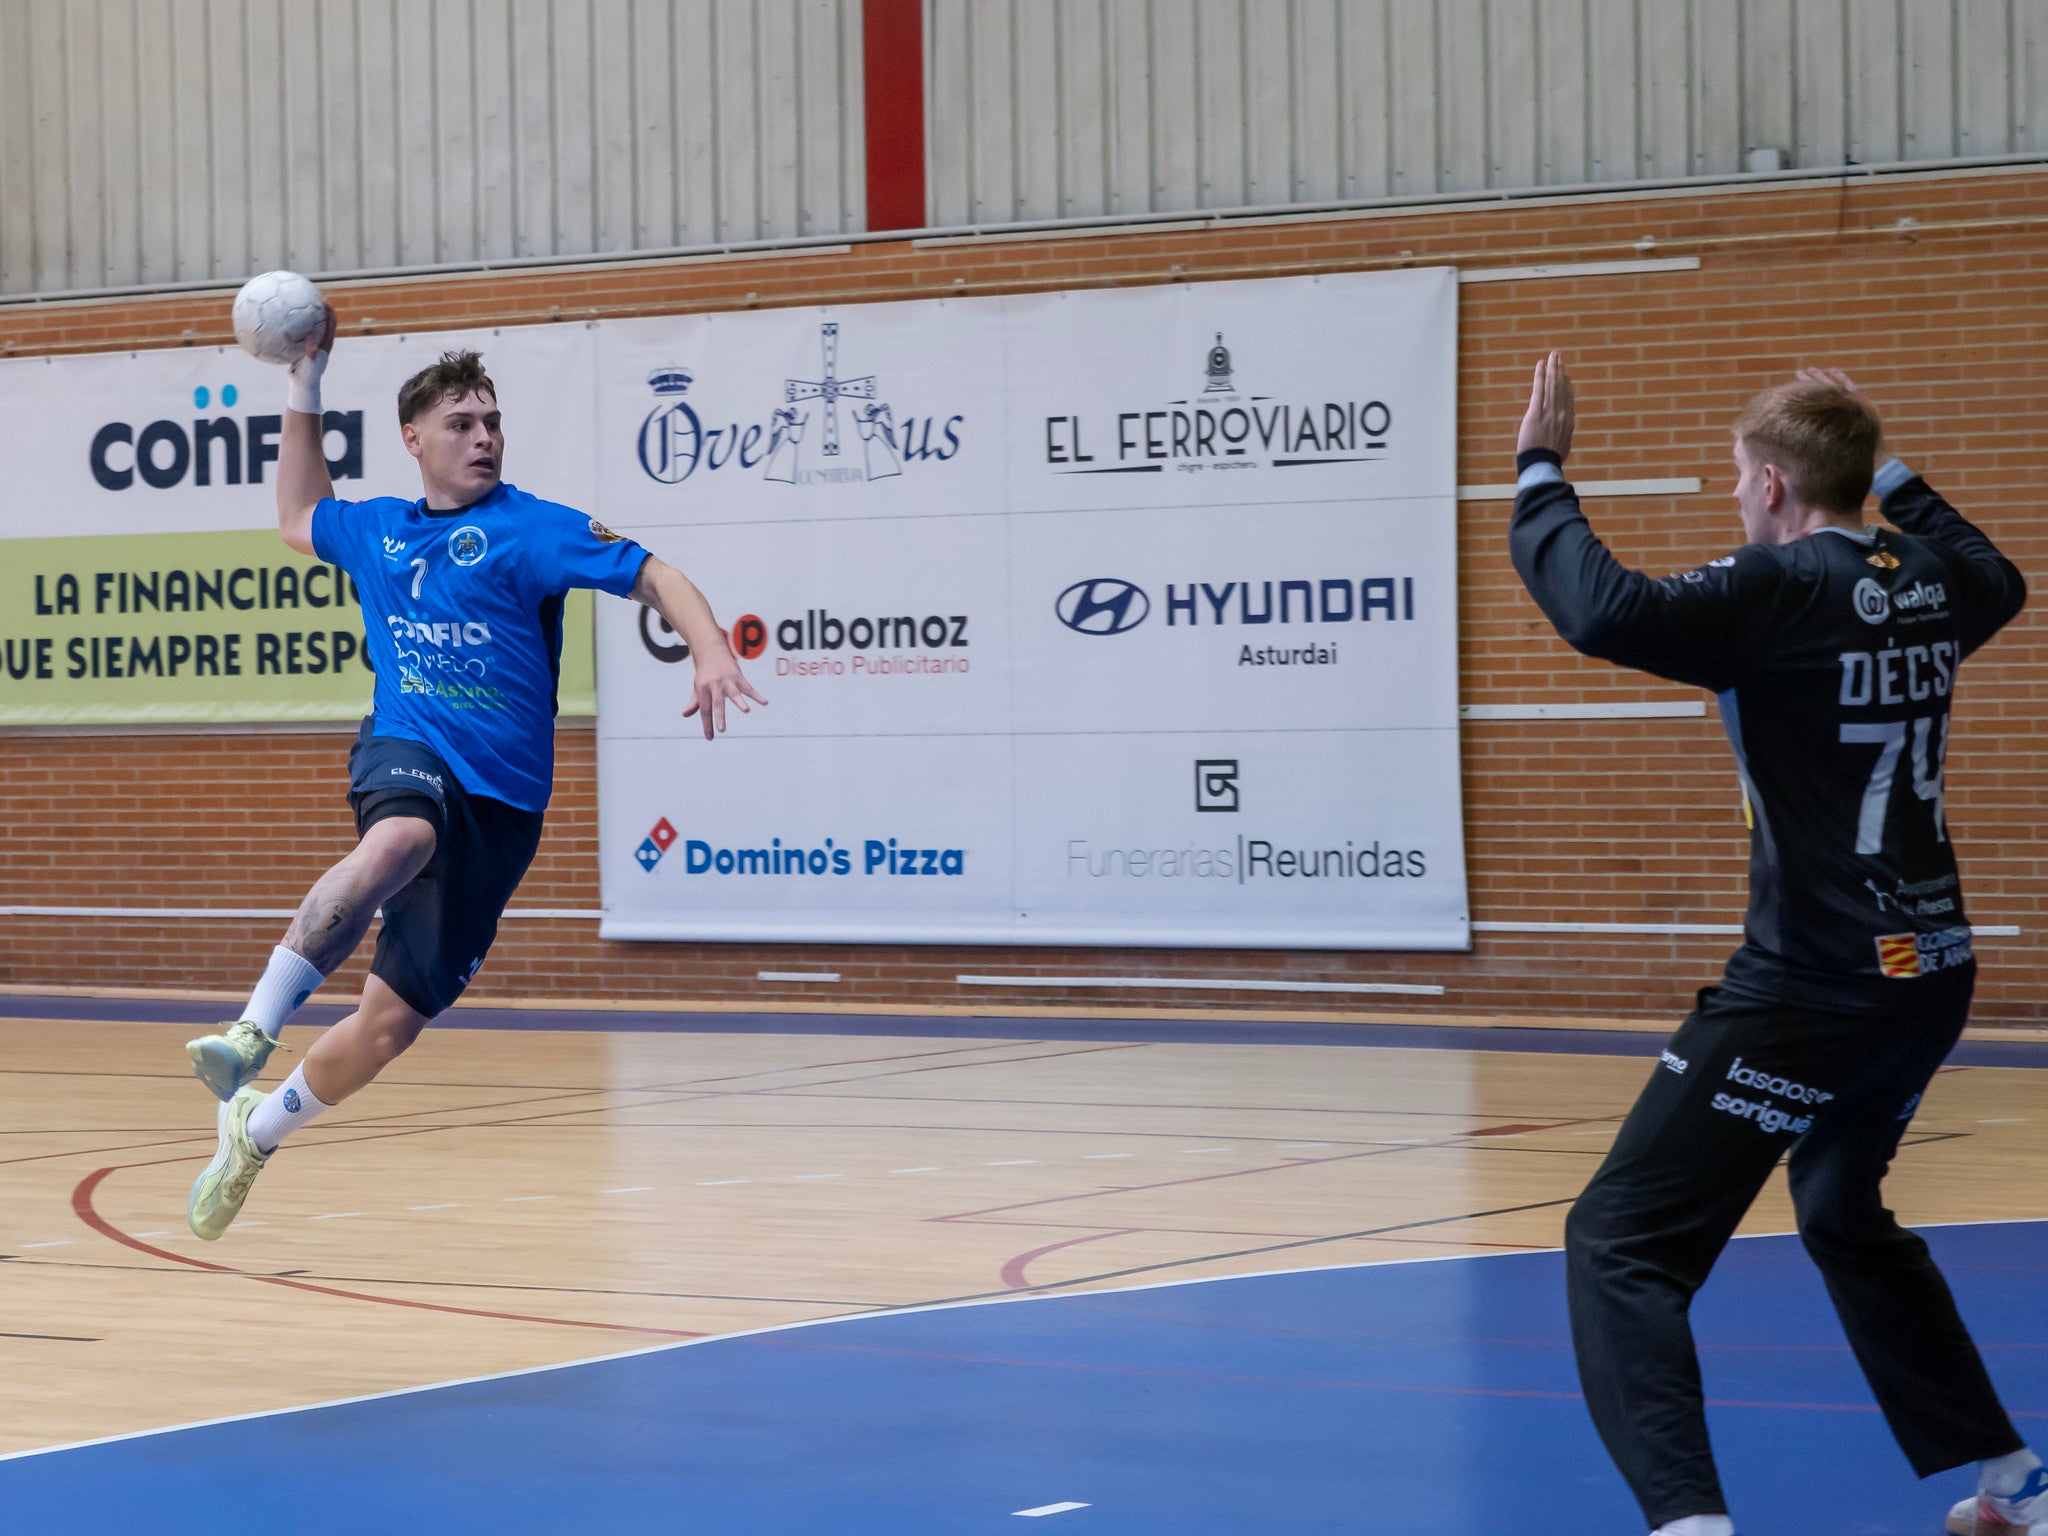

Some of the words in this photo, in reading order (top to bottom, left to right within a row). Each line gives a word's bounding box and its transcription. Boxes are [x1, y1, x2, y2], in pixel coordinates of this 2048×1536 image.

[1047, 415, 1093, 463] EL
[1119, 401, 1391, 460] FERROVIARIO
[35, 574, 80, 616] LA
[95, 565, 361, 614] FINANCIACI
[411, 558, 429, 600] 7
[1166, 577, 1415, 626] HYUNDAI
[776, 610, 968, 652] albornoz
[0, 637, 54, 680] UE
[67, 633, 242, 679] SIEMPRE
[776, 656, 844, 677] Diseño
[852, 654, 970, 676] Publicitario
[1239, 642, 1338, 667] Asturdai
[1839, 713, 1949, 856] 74
[685, 838, 850, 876] Domino's
[864, 838, 963, 876] Pizza
[1711, 1092, 1815, 1134] sorigué
